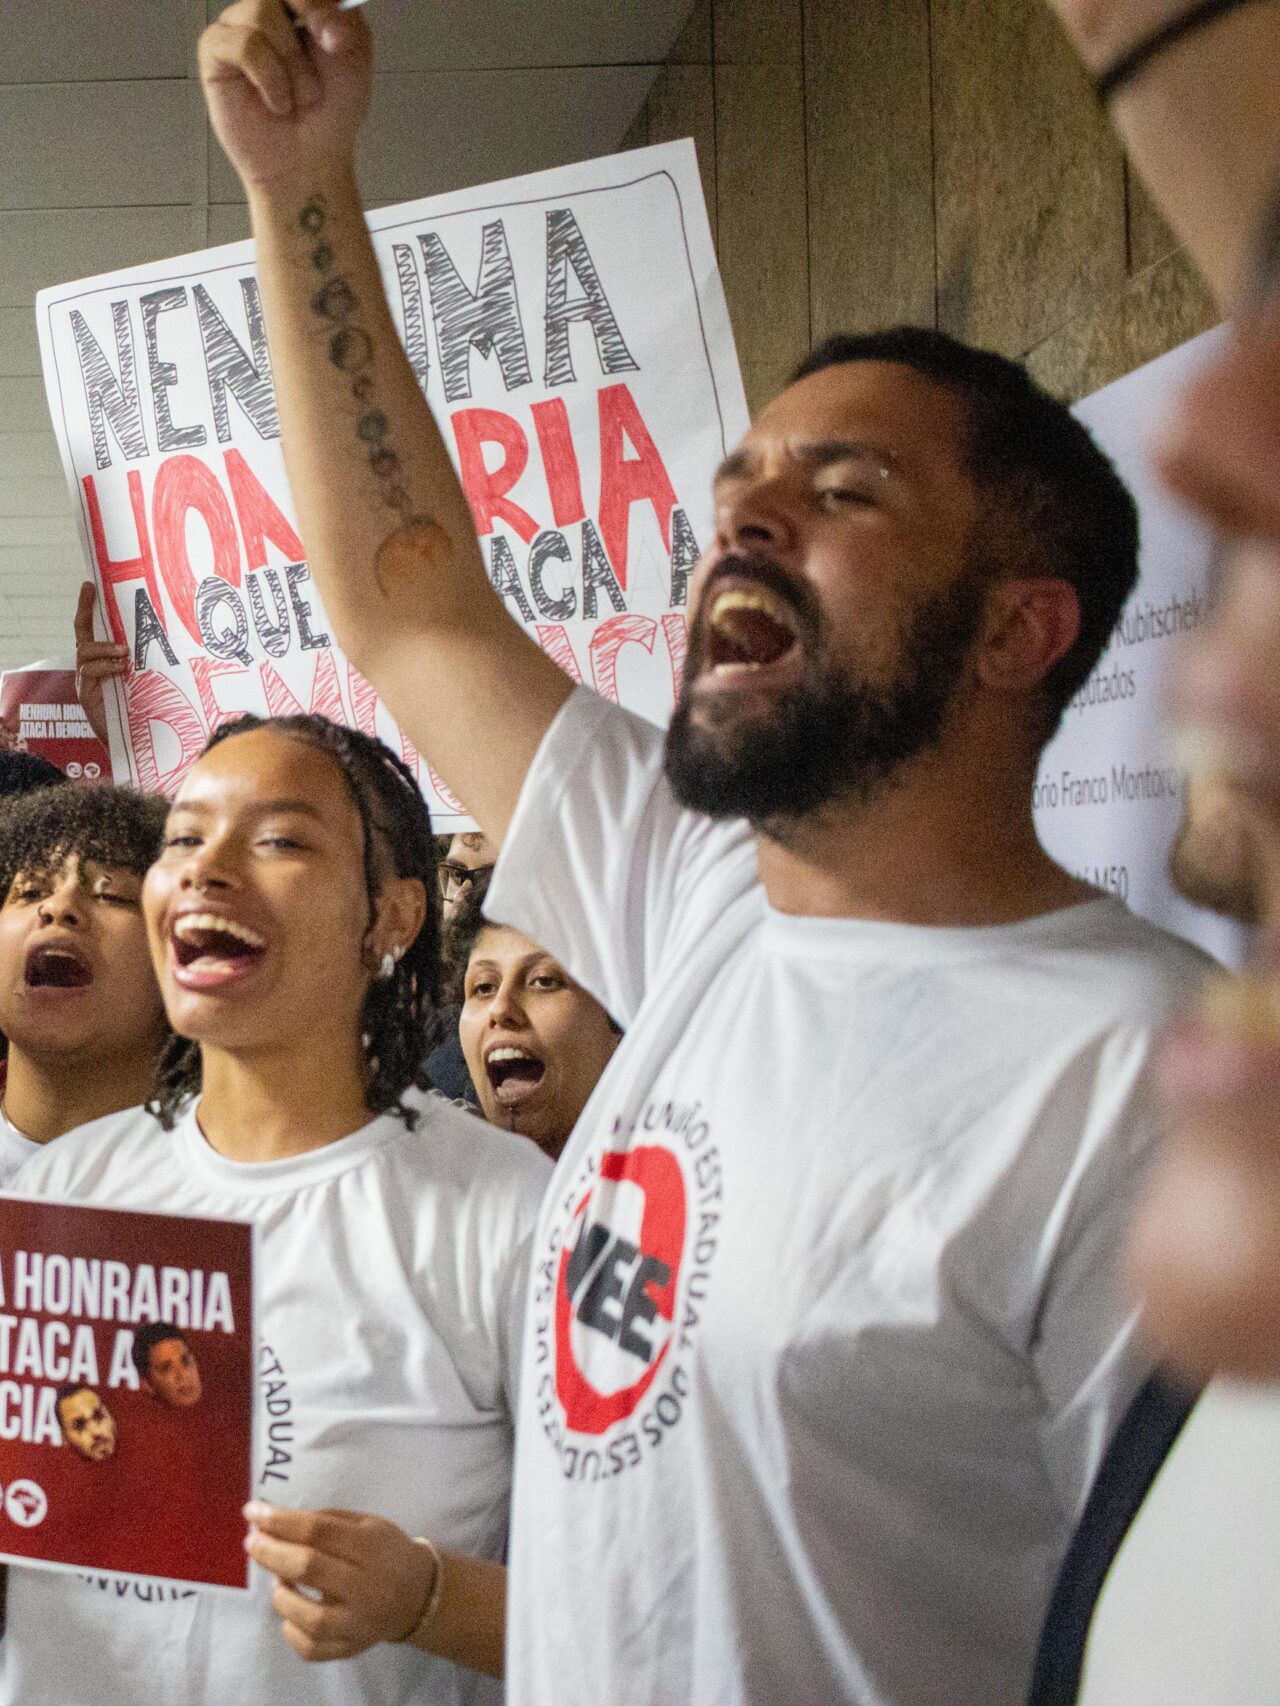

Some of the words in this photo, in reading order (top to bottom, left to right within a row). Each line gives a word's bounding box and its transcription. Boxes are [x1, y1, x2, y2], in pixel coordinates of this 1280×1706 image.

[83, 383, 682, 647] HONRIA
[135, 587, 180, 670] A
[490, 518, 628, 623] ACA
[1062, 770, 1108, 807] Franco
[15, 1250, 236, 1334] HONRARIA
[108, 1328, 140, 1391] A
